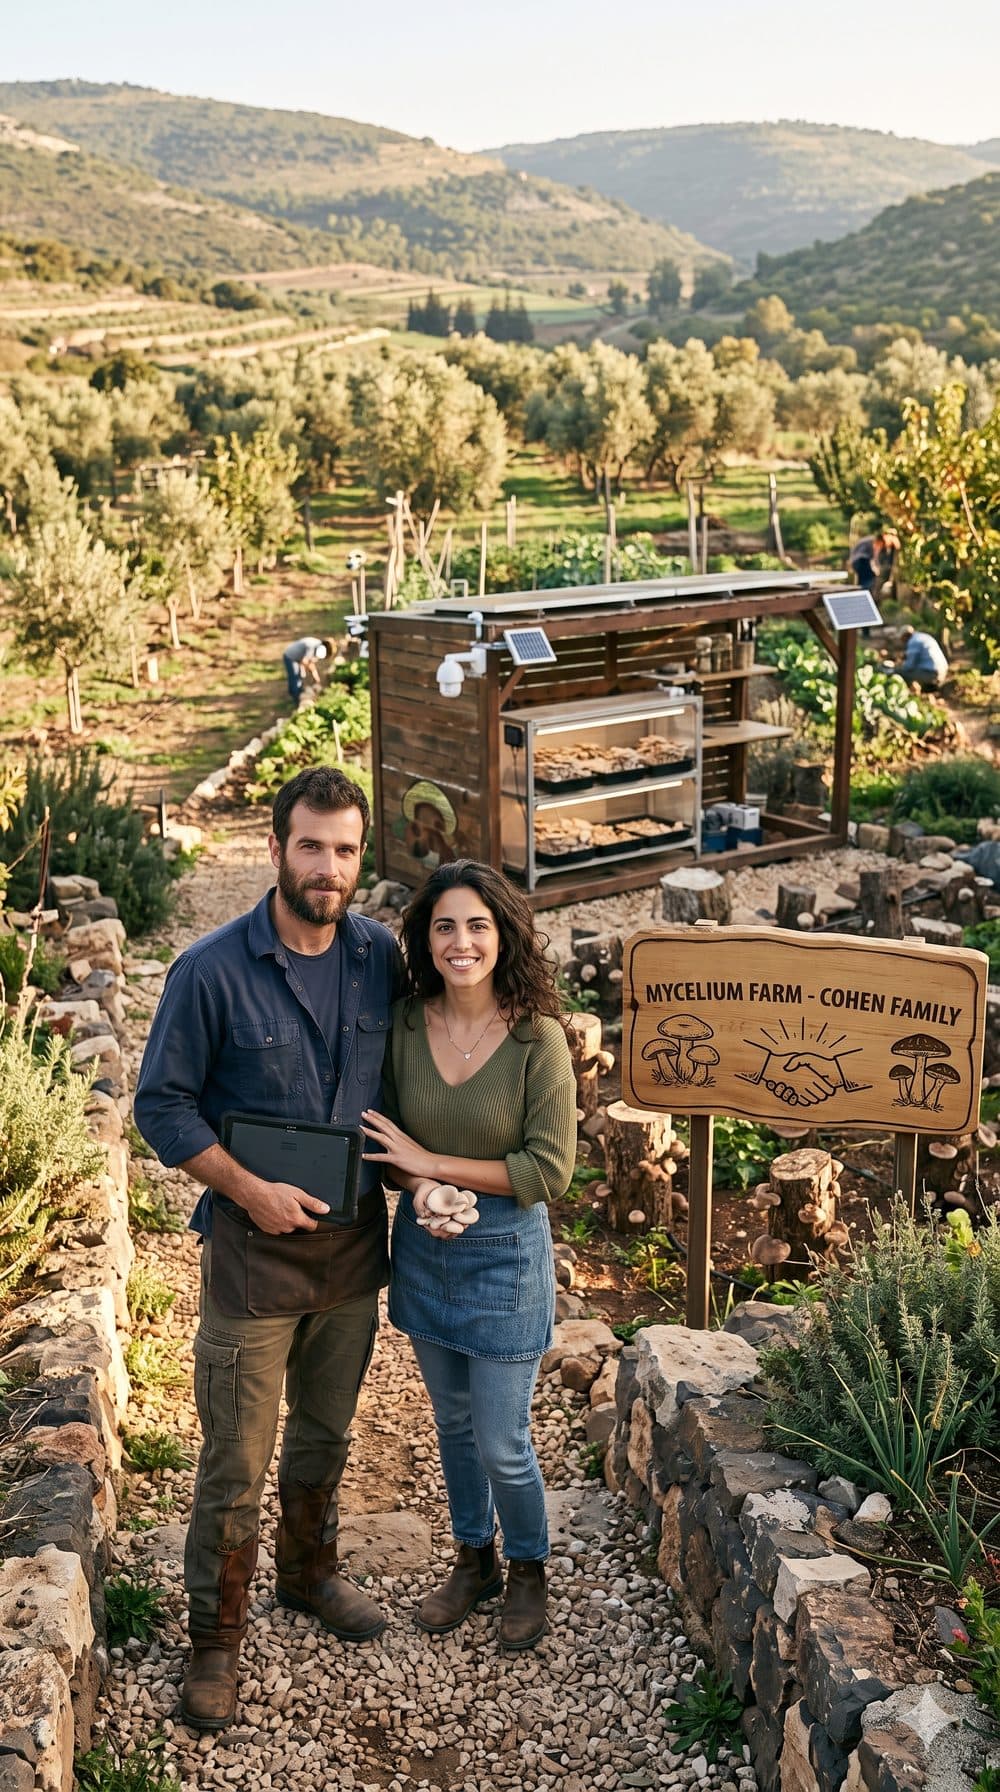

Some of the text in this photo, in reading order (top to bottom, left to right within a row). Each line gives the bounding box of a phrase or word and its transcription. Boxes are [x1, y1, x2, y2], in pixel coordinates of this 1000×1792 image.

[646, 981, 744, 1004] MYCELIUM
[749, 982, 802, 1004] FARM
[820, 987, 886, 1014] COHEN
[890, 996, 963, 1027] FAMILY
